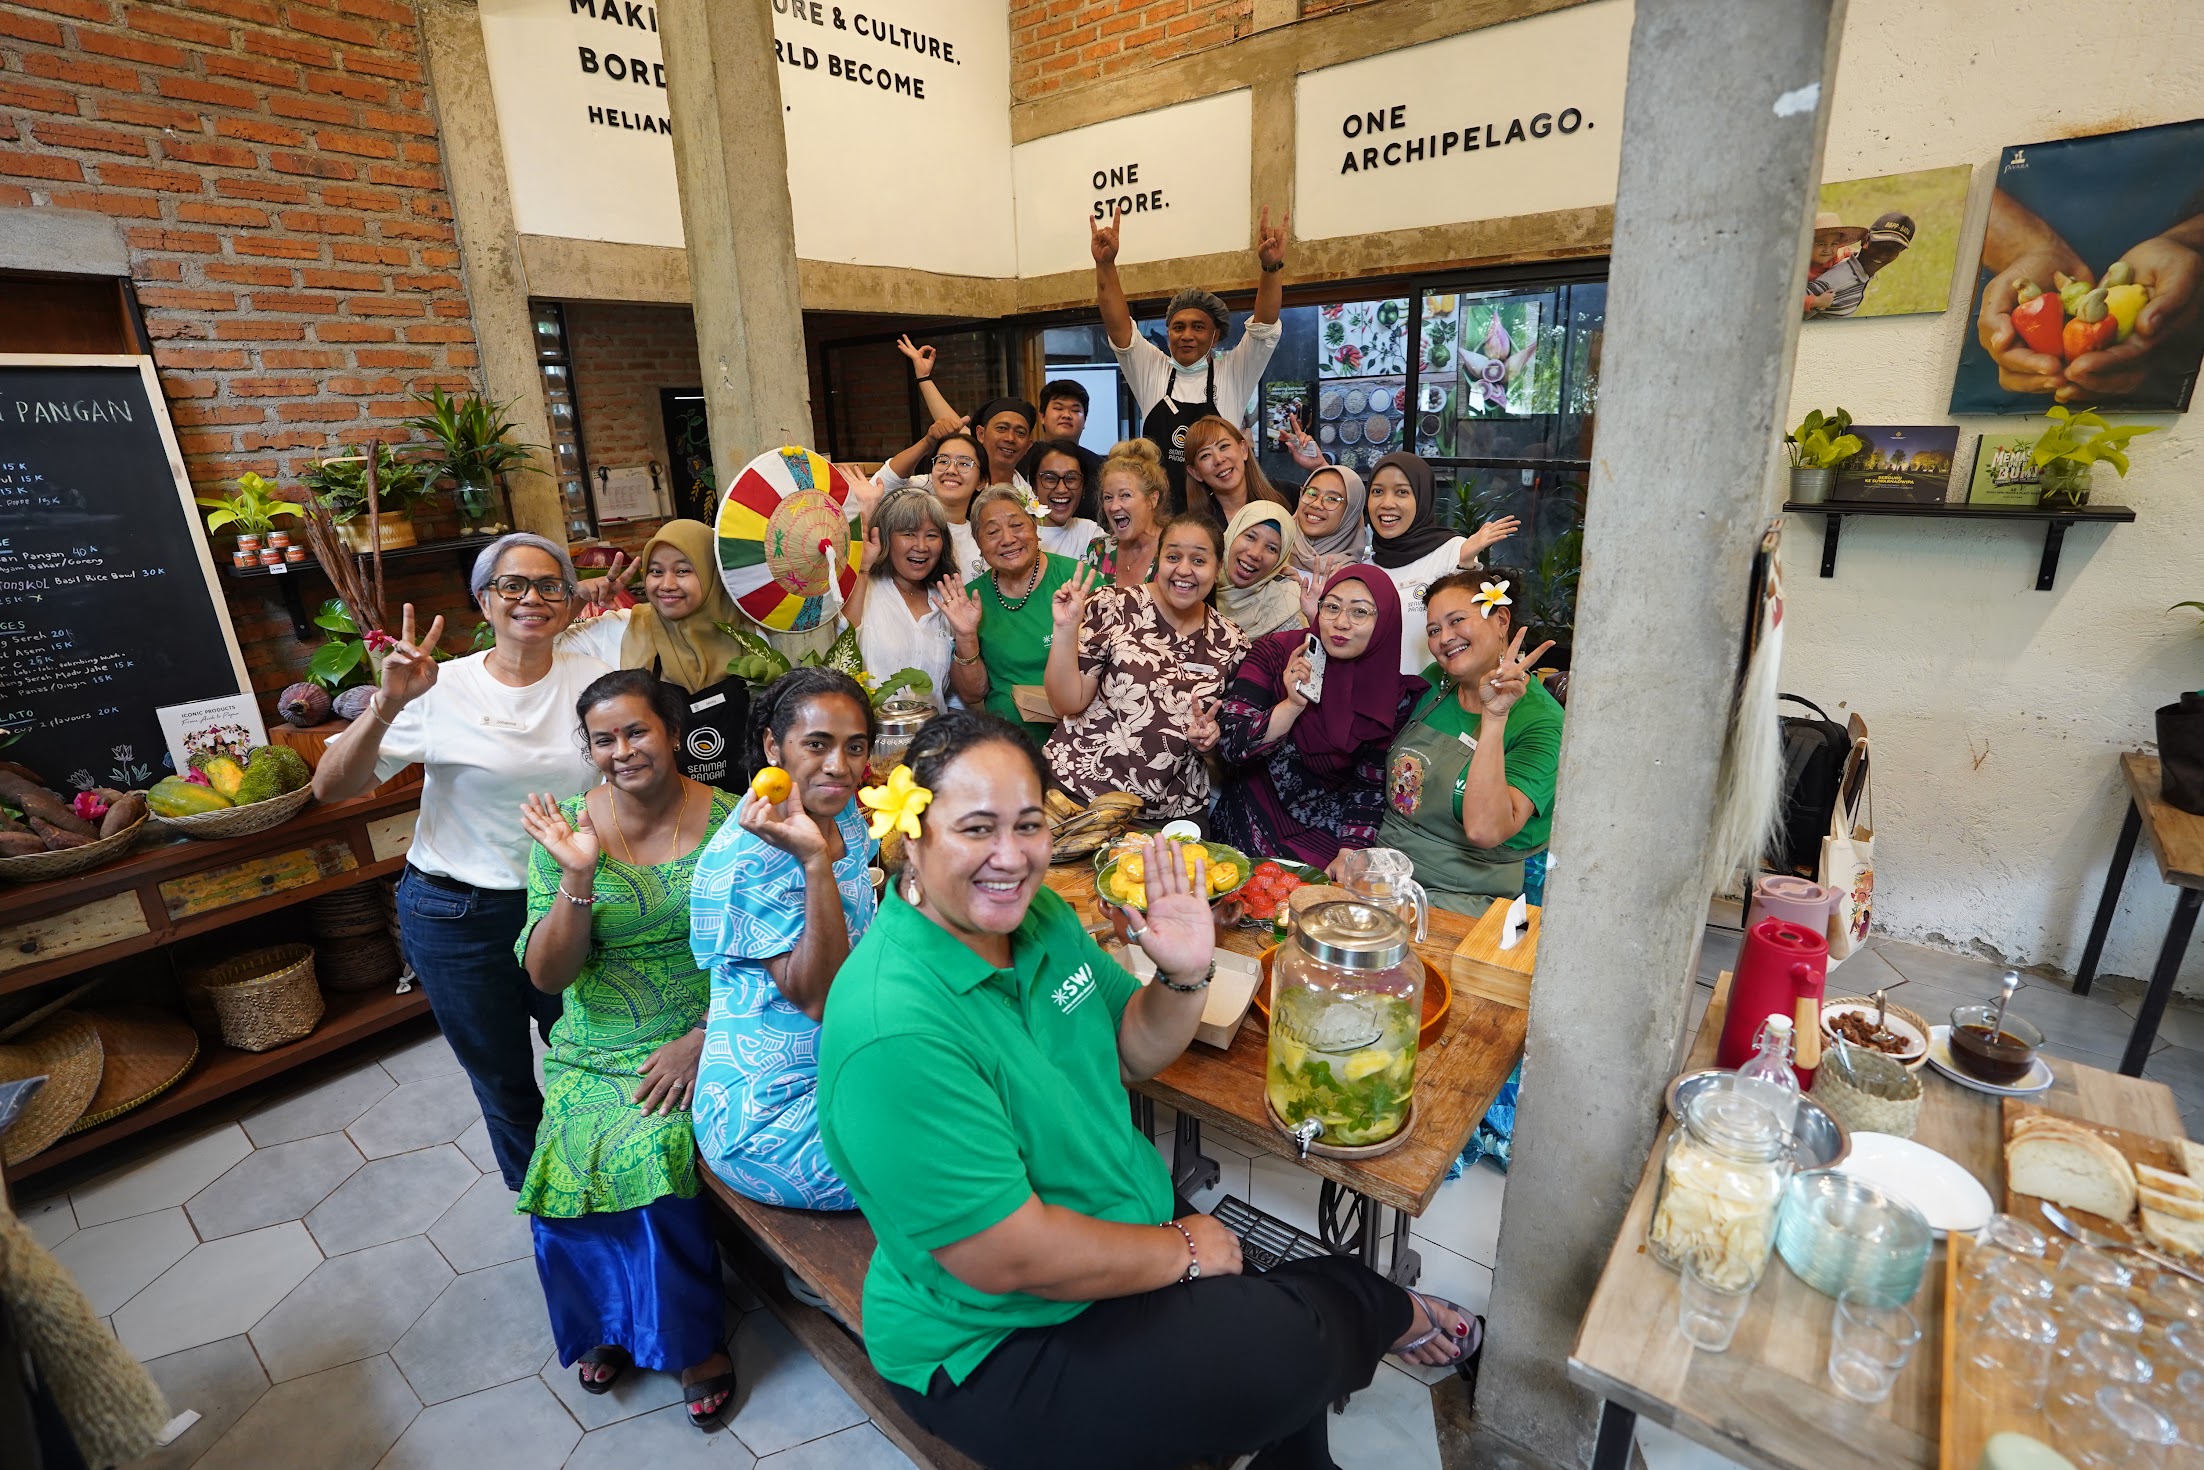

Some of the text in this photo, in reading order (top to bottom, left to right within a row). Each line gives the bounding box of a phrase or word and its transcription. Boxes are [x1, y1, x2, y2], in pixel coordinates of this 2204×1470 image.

[833, 6, 846, 30] &
[854, 13, 961, 65] CULTURE.
[828, 53, 925, 99] BECOME
[1342, 104, 1406, 138] ONE
[1340, 107, 1594, 175] ARCHIPELAGO.
[1092, 163, 1139, 190] ONE
[1093, 189, 1170, 220] STORE.
[16, 400, 133, 424] PANGAN
[22, 550, 65, 561] Pangan
[111, 570, 136, 580] Bowl
[12, 631, 48, 644] Sereh
[15, 647, 46, 657] Asem
[24, 673, 53, 683] Sereh
[84, 664, 109, 674] Jahe
[50, 711, 92, 728] flavours
[181, 704, 236, 718] ICONIC PRODUCTS
[687, 759, 727, 774] SENIMAN
[690, 768, 726, 782] PANGAN
